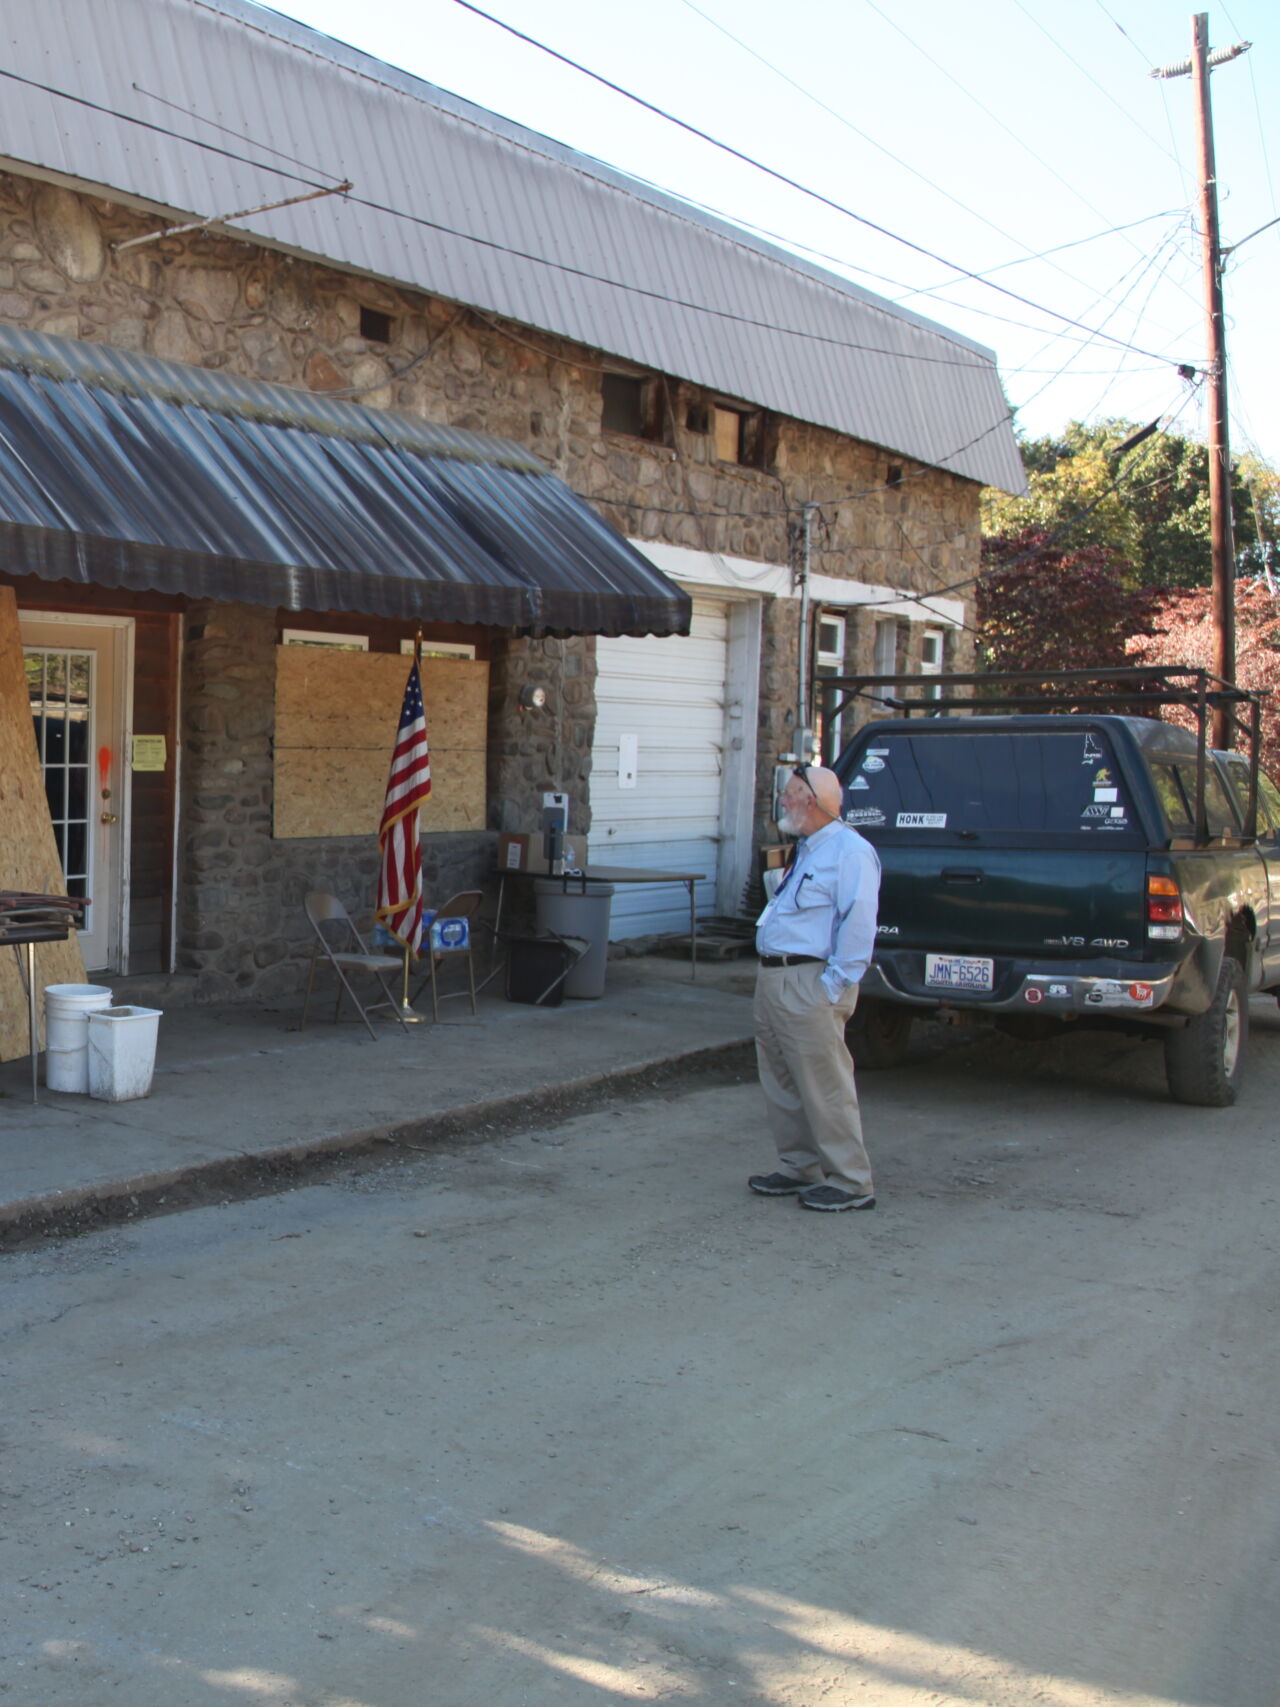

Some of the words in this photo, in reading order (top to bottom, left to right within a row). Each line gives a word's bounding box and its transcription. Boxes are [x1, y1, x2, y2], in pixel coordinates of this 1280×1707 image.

[899, 815, 924, 825] HONK
[1062, 936, 1085, 946] V8
[1090, 939, 1129, 948] 4WD
[929, 963, 990, 983] JMN-6526
